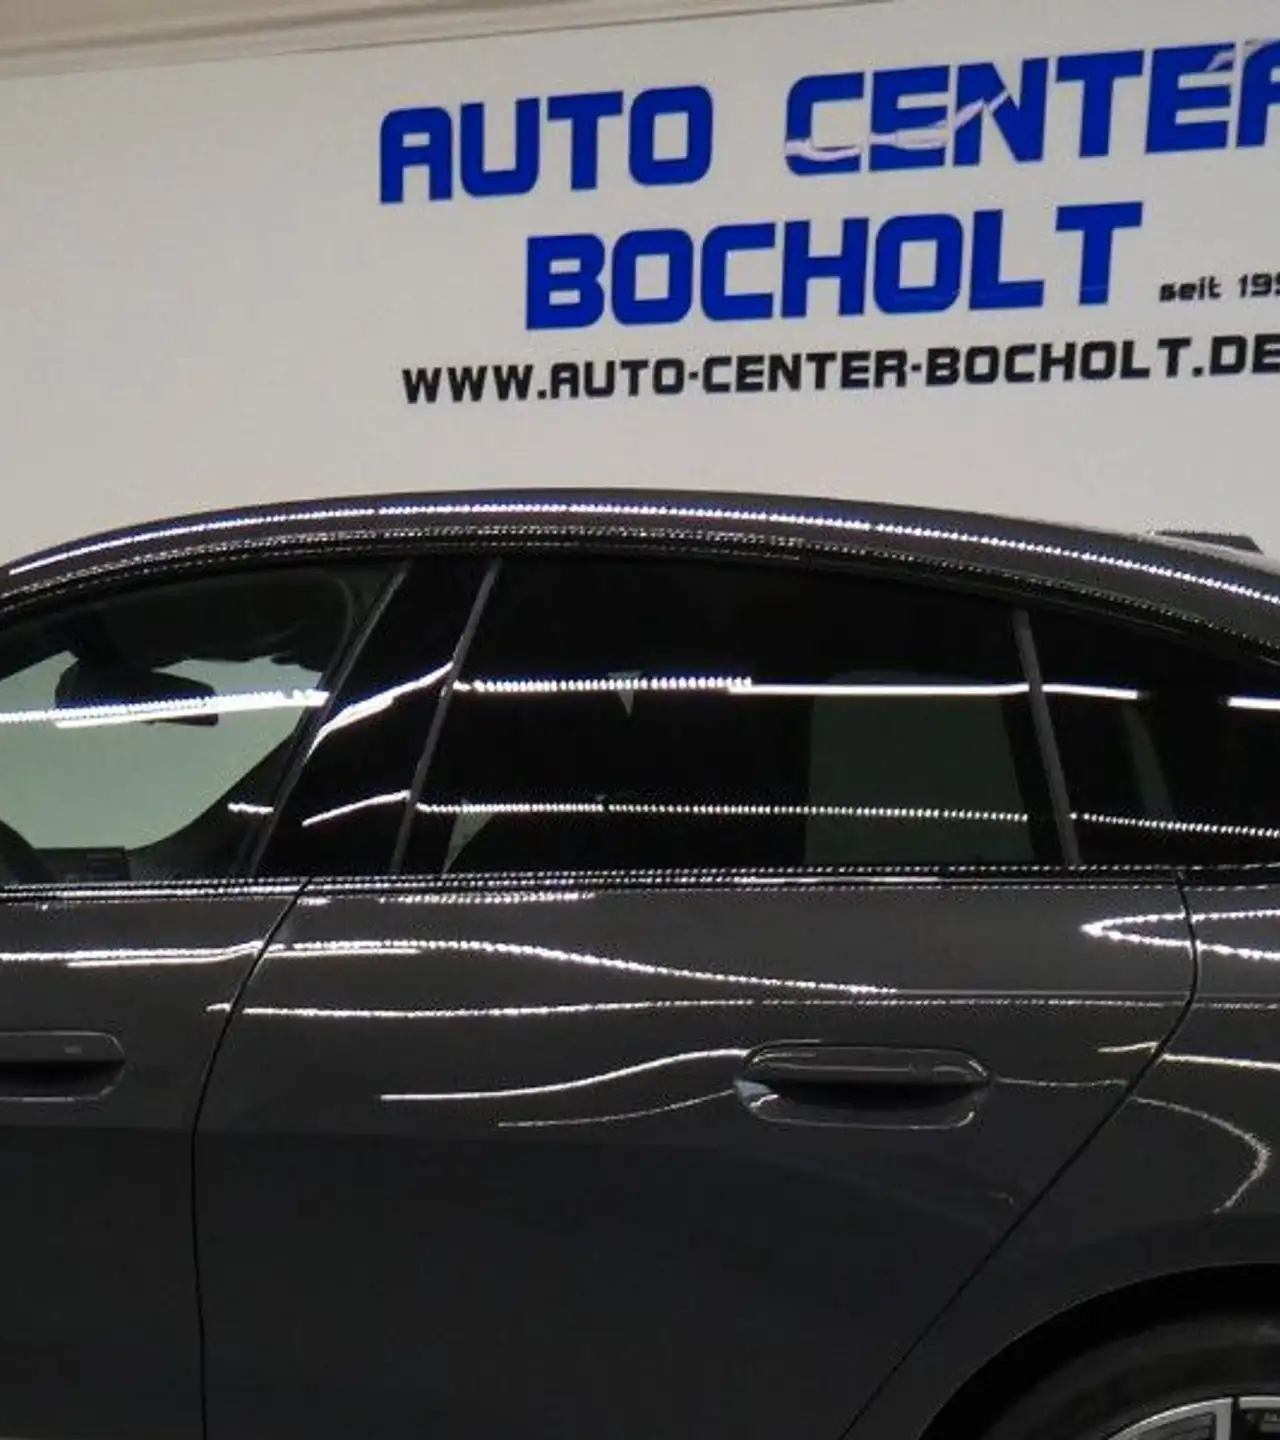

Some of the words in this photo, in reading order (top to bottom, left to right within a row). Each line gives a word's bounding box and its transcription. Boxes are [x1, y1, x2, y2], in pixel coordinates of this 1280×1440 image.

[379, 85, 715, 207] AUTO
[525, 200, 1144, 332] BOCHOLT
[1159, 275, 1222, 303] seit
